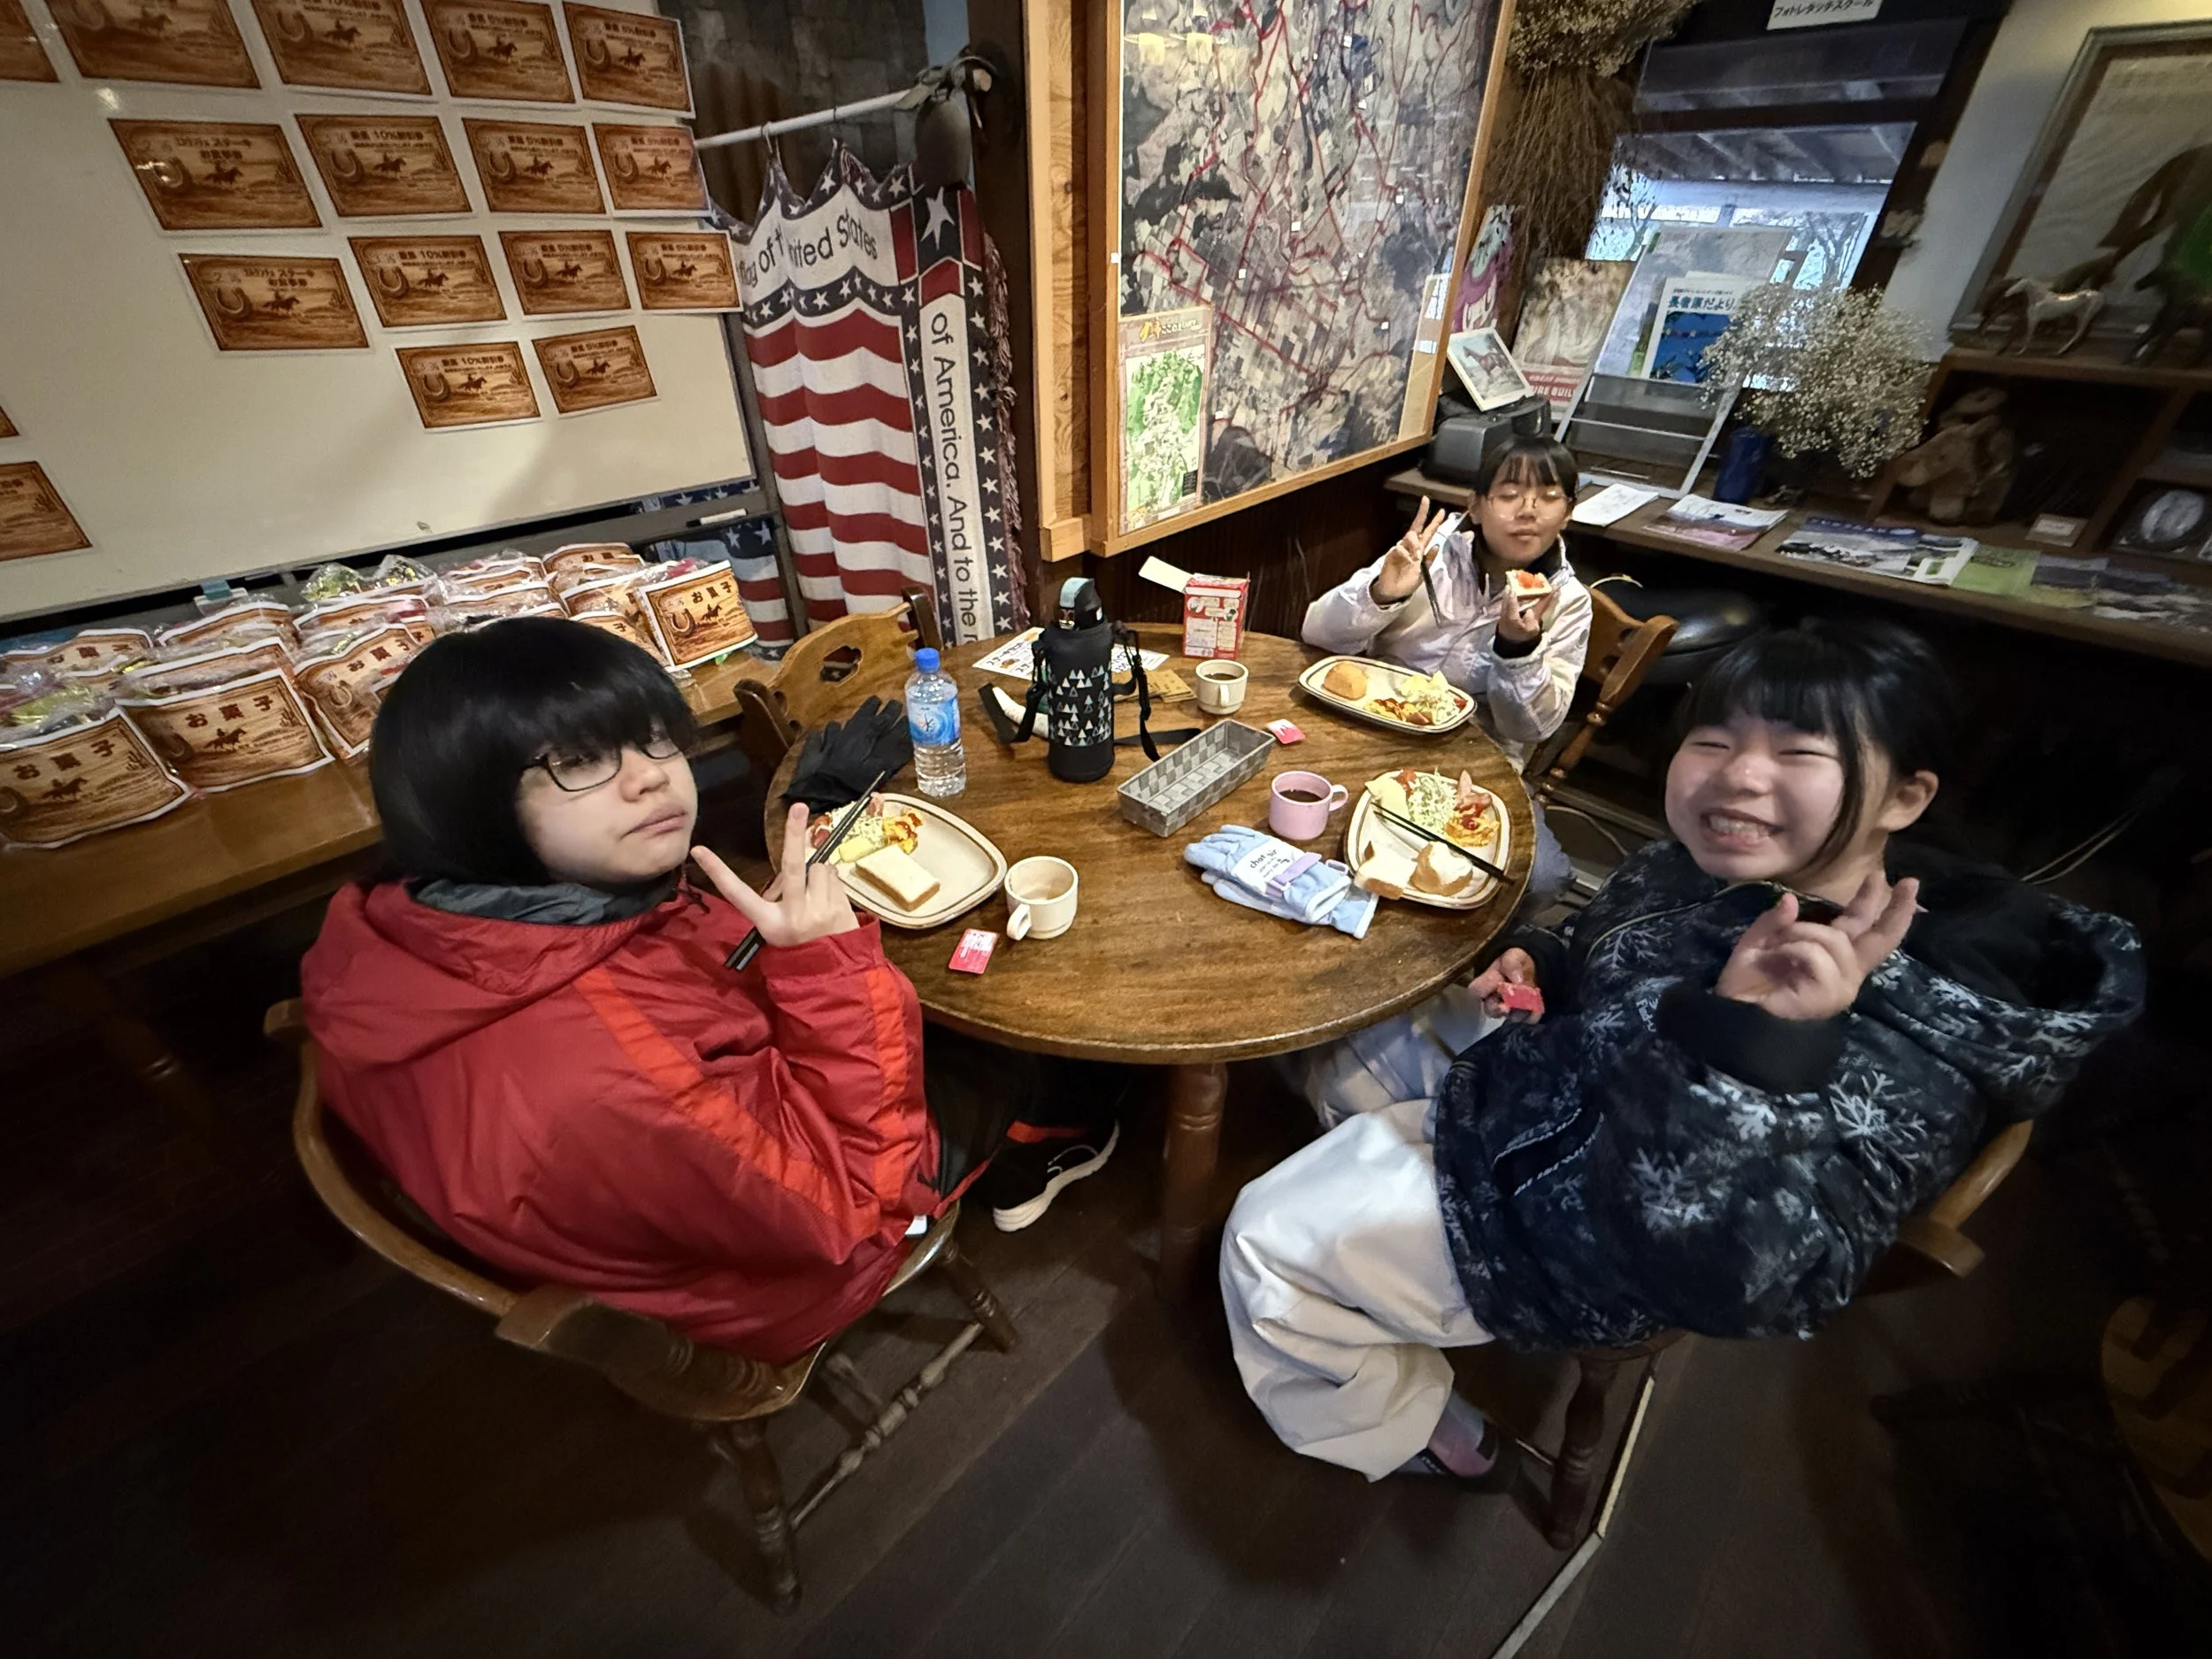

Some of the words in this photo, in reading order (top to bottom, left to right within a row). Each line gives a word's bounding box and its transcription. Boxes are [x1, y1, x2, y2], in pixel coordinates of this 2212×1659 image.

[758, 236, 776, 273] of
[836, 207, 878, 260] States
[931, 312, 954, 344] of
[933, 357, 962, 488] America.
[947, 495, 972, 550] And
[954, 557, 973, 582] to
[958, 589, 979, 627] the
[184, 695, 273, 728] お菓子
[12, 740, 115, 780] お菓子
